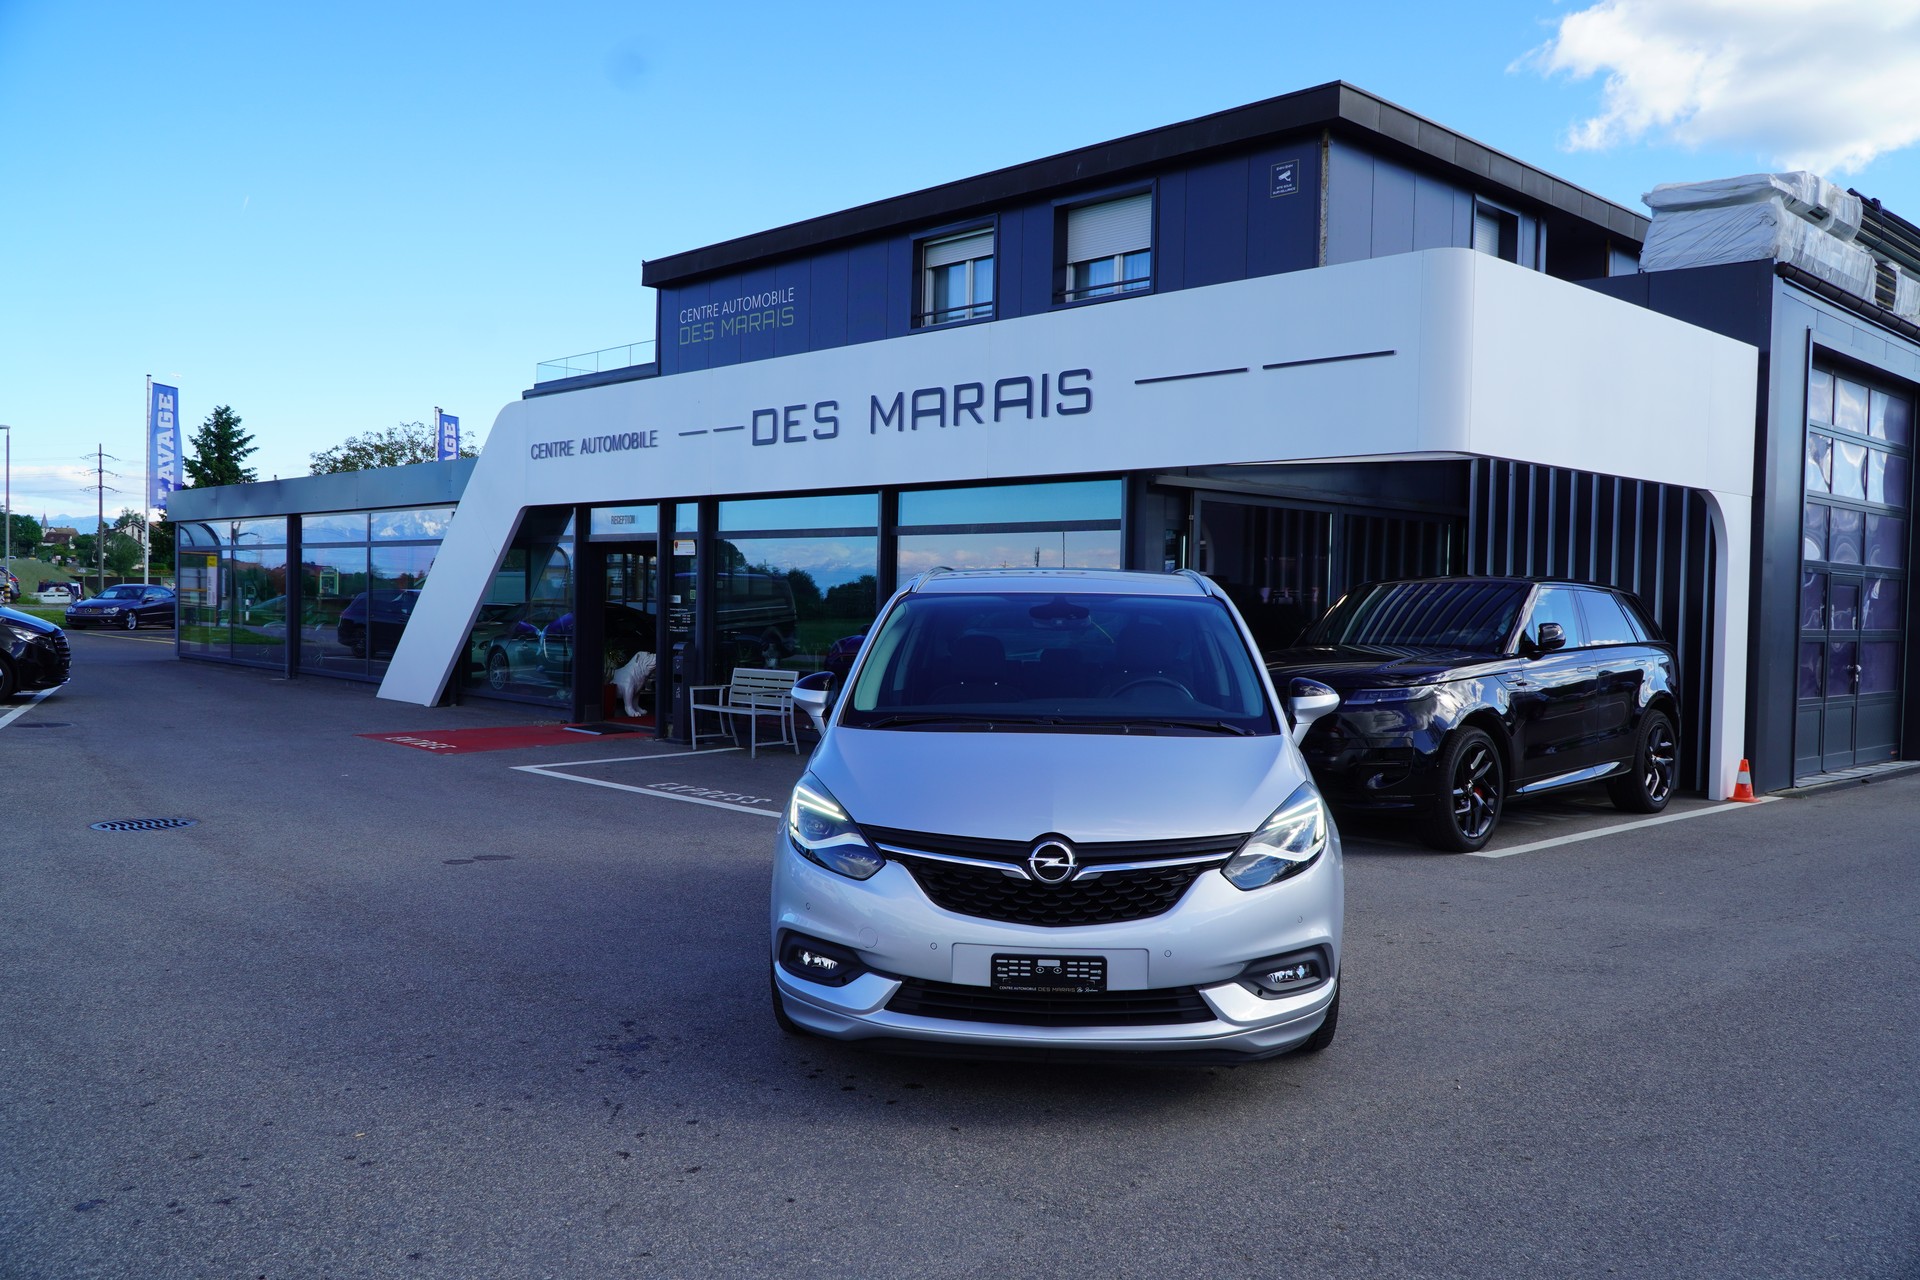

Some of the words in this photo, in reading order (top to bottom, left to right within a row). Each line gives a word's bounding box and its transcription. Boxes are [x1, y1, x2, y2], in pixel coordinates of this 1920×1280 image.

[679, 302, 719, 324] CENTRE
[721, 287, 795, 315] AUTOMOBILE
[679, 321, 715, 345] DES
[721, 306, 794, 338] MARAIS
[530, 439, 575, 460] CENTRE
[580, 429, 658, 455] AUTOMOBILE
[751, 399, 839, 446] DES
[870, 368, 1093, 434] MARAIS
[646, 782, 772, 804] EXPRESS
